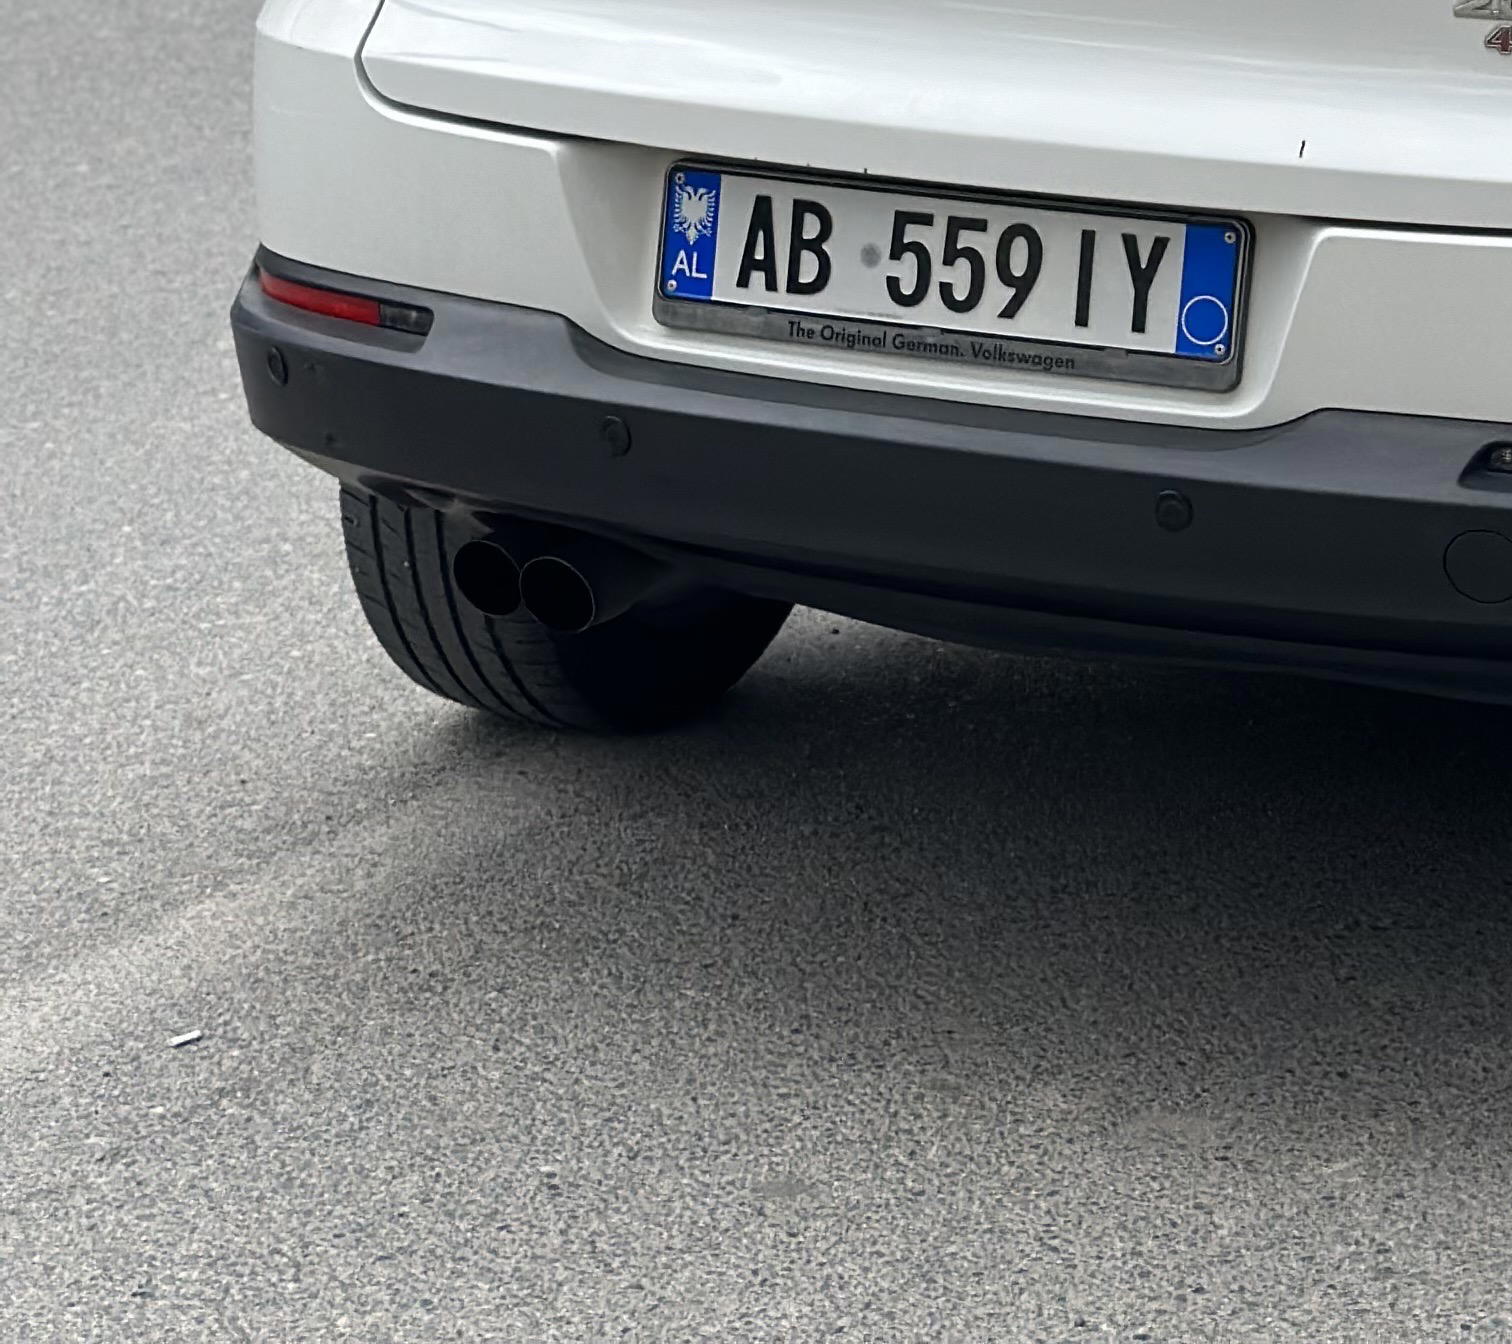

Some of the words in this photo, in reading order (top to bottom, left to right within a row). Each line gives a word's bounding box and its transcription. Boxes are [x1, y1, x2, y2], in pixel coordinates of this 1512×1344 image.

[671, 249, 708, 279] AL
[735, 194, 834, 295] AB
[885, 209, 1044, 320] 559
[1074, 228, 1170, 334] IY
[787, 320, 815, 339] The
[820, 324, 887, 348] Original
[892, 333, 964, 357] German.
[970, 341, 1076, 371] Volkswagen
